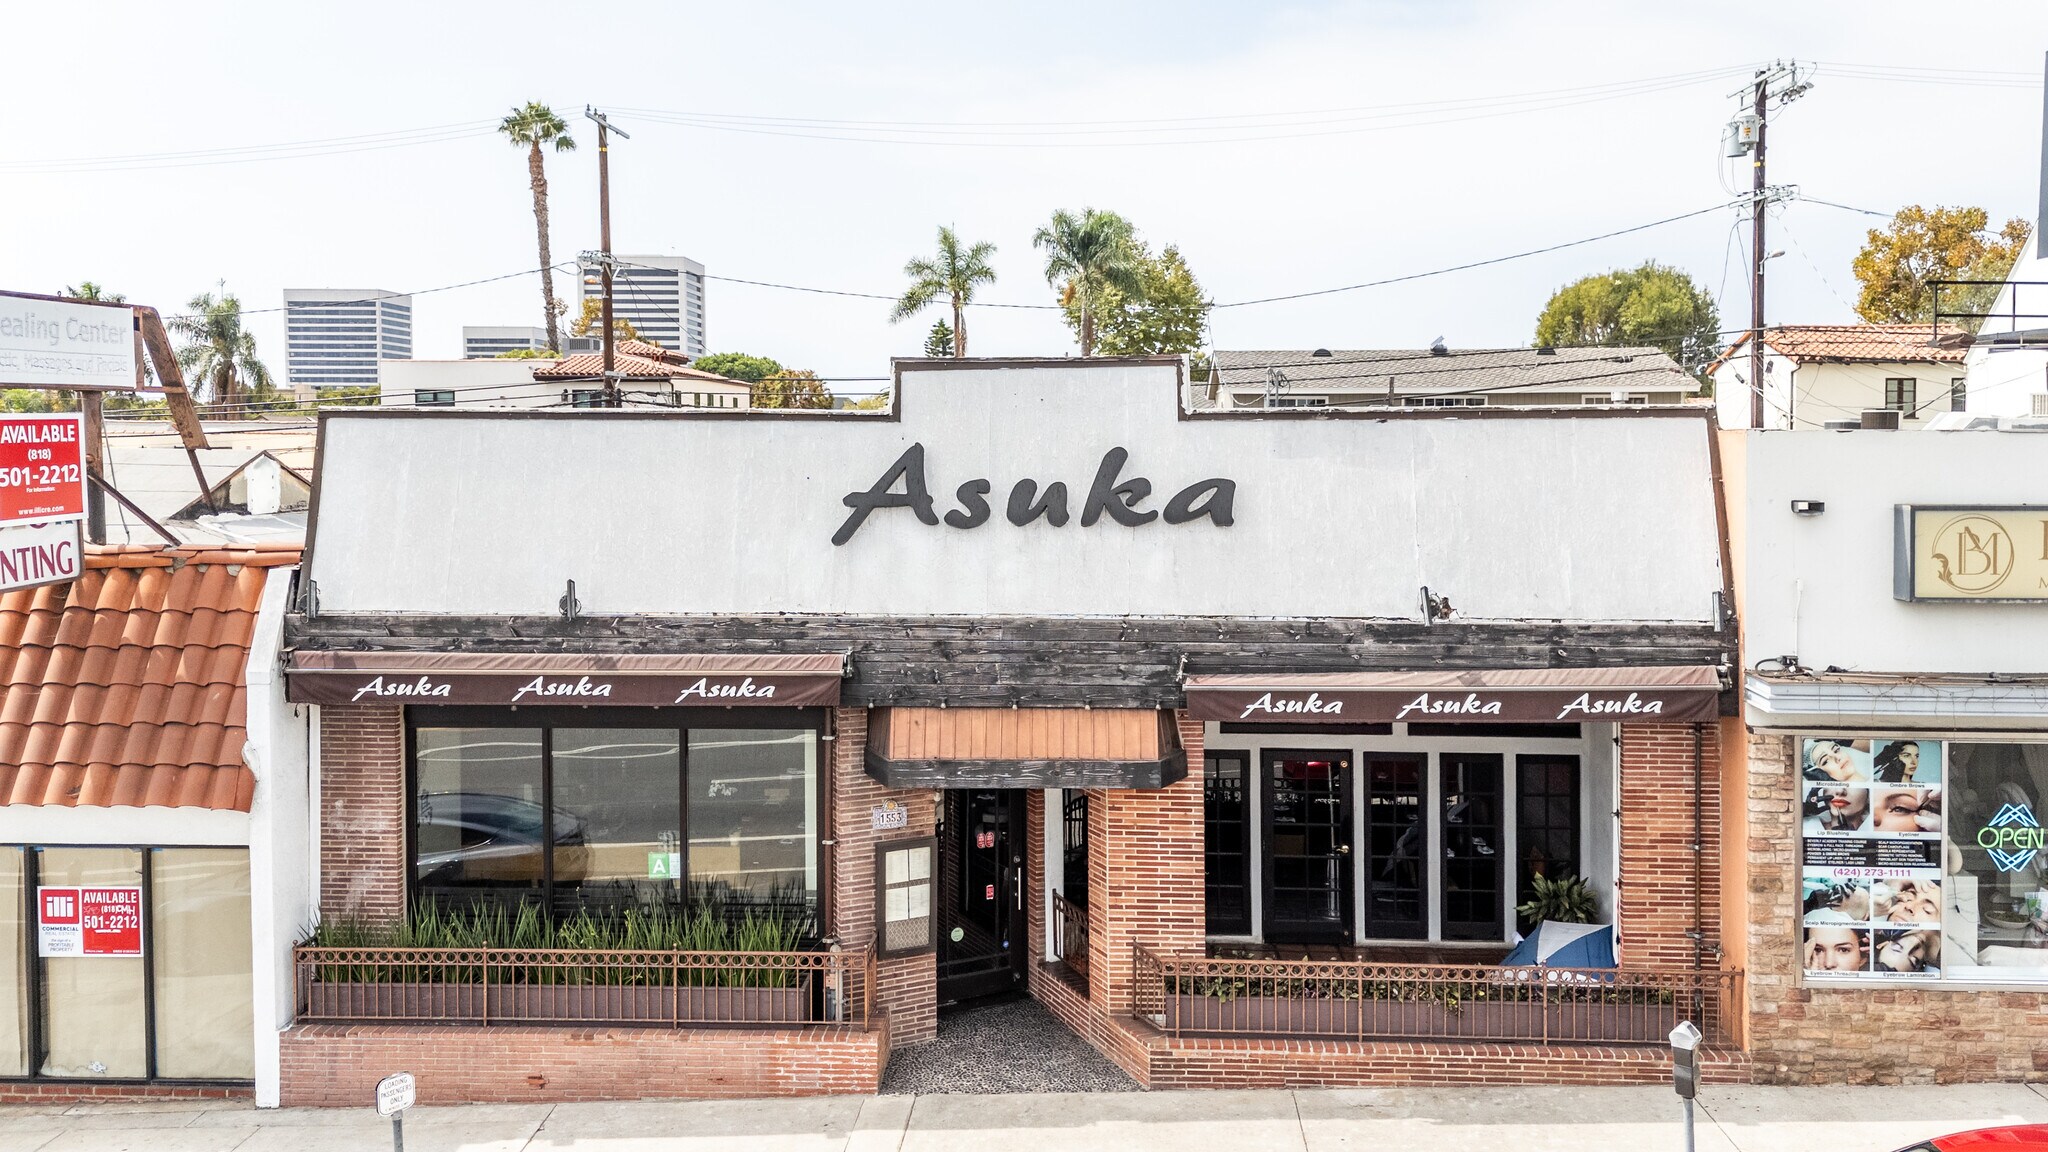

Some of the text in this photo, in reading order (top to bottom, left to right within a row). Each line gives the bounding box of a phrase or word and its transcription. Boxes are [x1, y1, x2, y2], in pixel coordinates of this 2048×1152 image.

[66, 316, 127, 344] Center
[0, 424, 75, 444] AVAILABLE
[28, 448, 52, 461] (818)
[0, 464, 79, 487] 501-2212
[831, 442, 1236, 546] Asuka
[0, 541, 73, 585] NTING
[351, 675, 776, 703] Asuka Asuka Asuka
[1240, 692, 1663, 719] Asuka Asuka Asuka
[880, 813, 902, 823] 1553
[1977, 827, 2044, 849] OPEN
[652, 859, 666, 873] A
[1833, 868, 1911, 877] (424) 273-1111
[84, 892, 137, 903] AVAILABLE
[84, 916, 137, 928] 501-2212
[390, 1095, 404, 1105] ONLY
